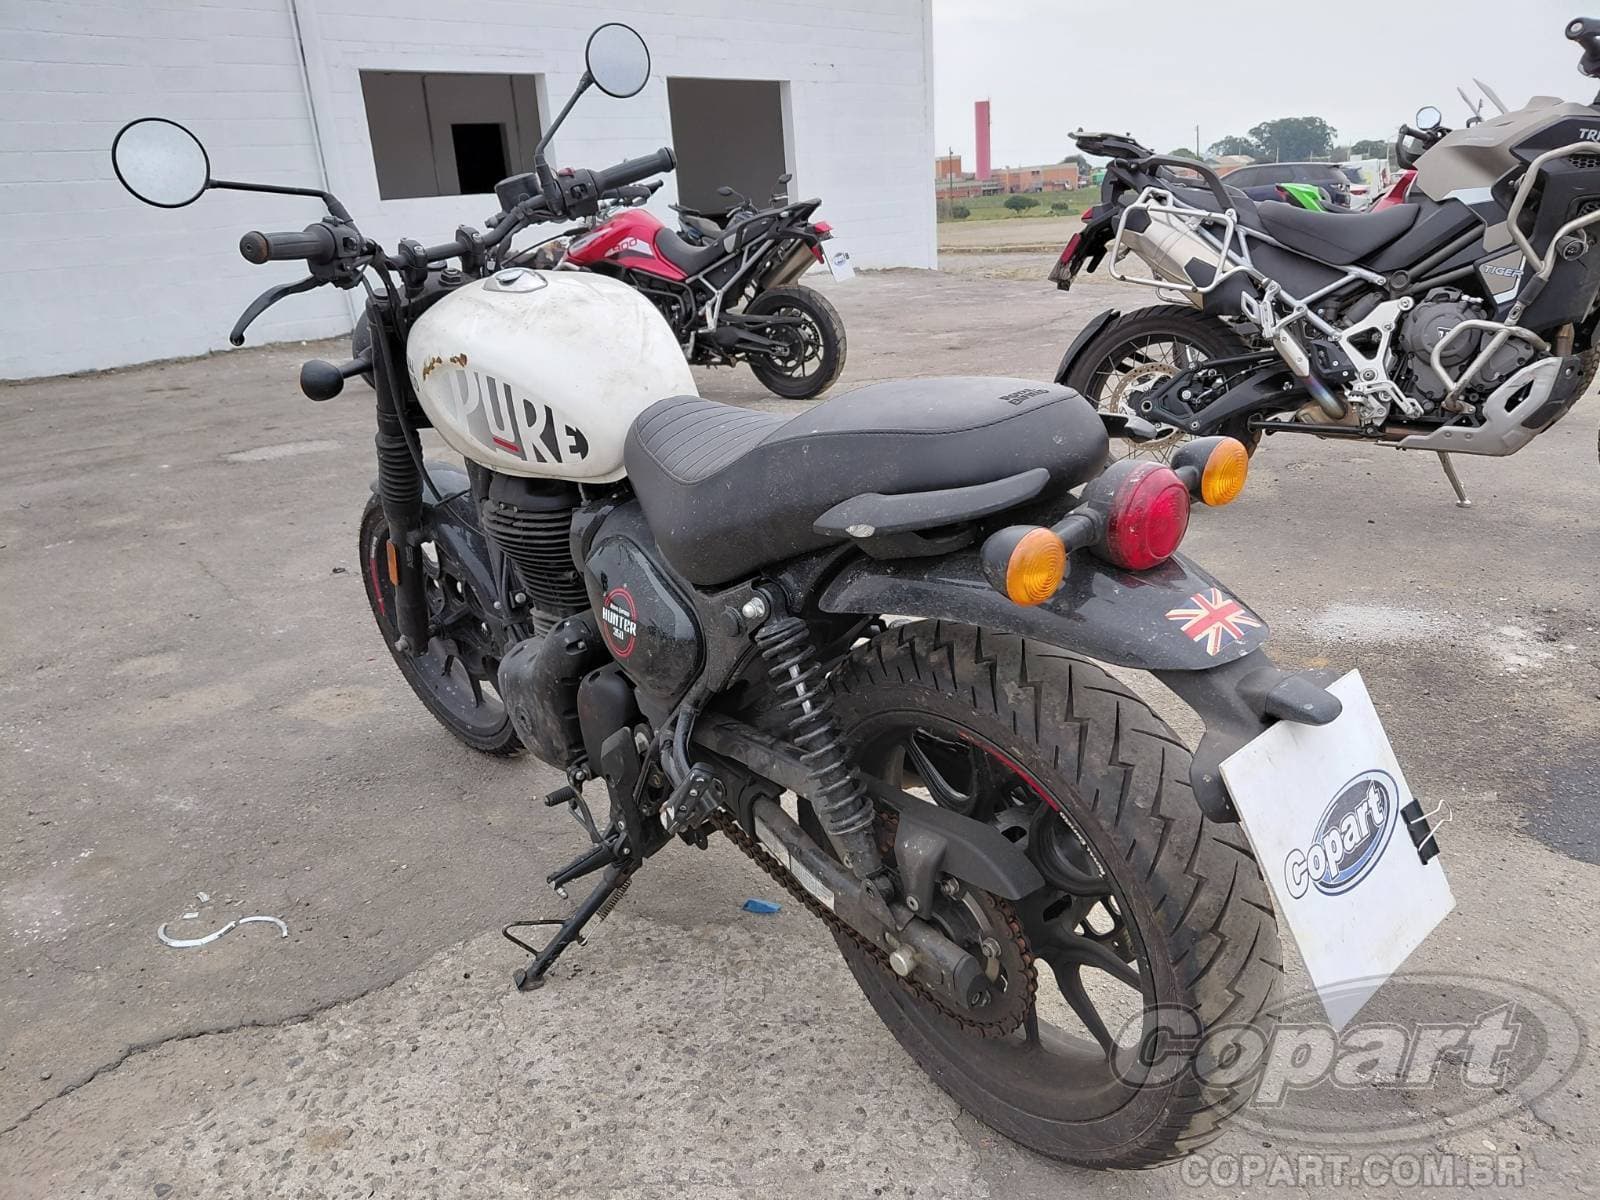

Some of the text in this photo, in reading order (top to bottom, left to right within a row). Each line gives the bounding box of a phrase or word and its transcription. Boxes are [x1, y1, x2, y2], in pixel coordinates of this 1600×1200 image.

[1484, 265, 1524, 278] TIGER
[602, 606, 637, 637] HUNTER
[1284, 779, 1386, 900] Copart
